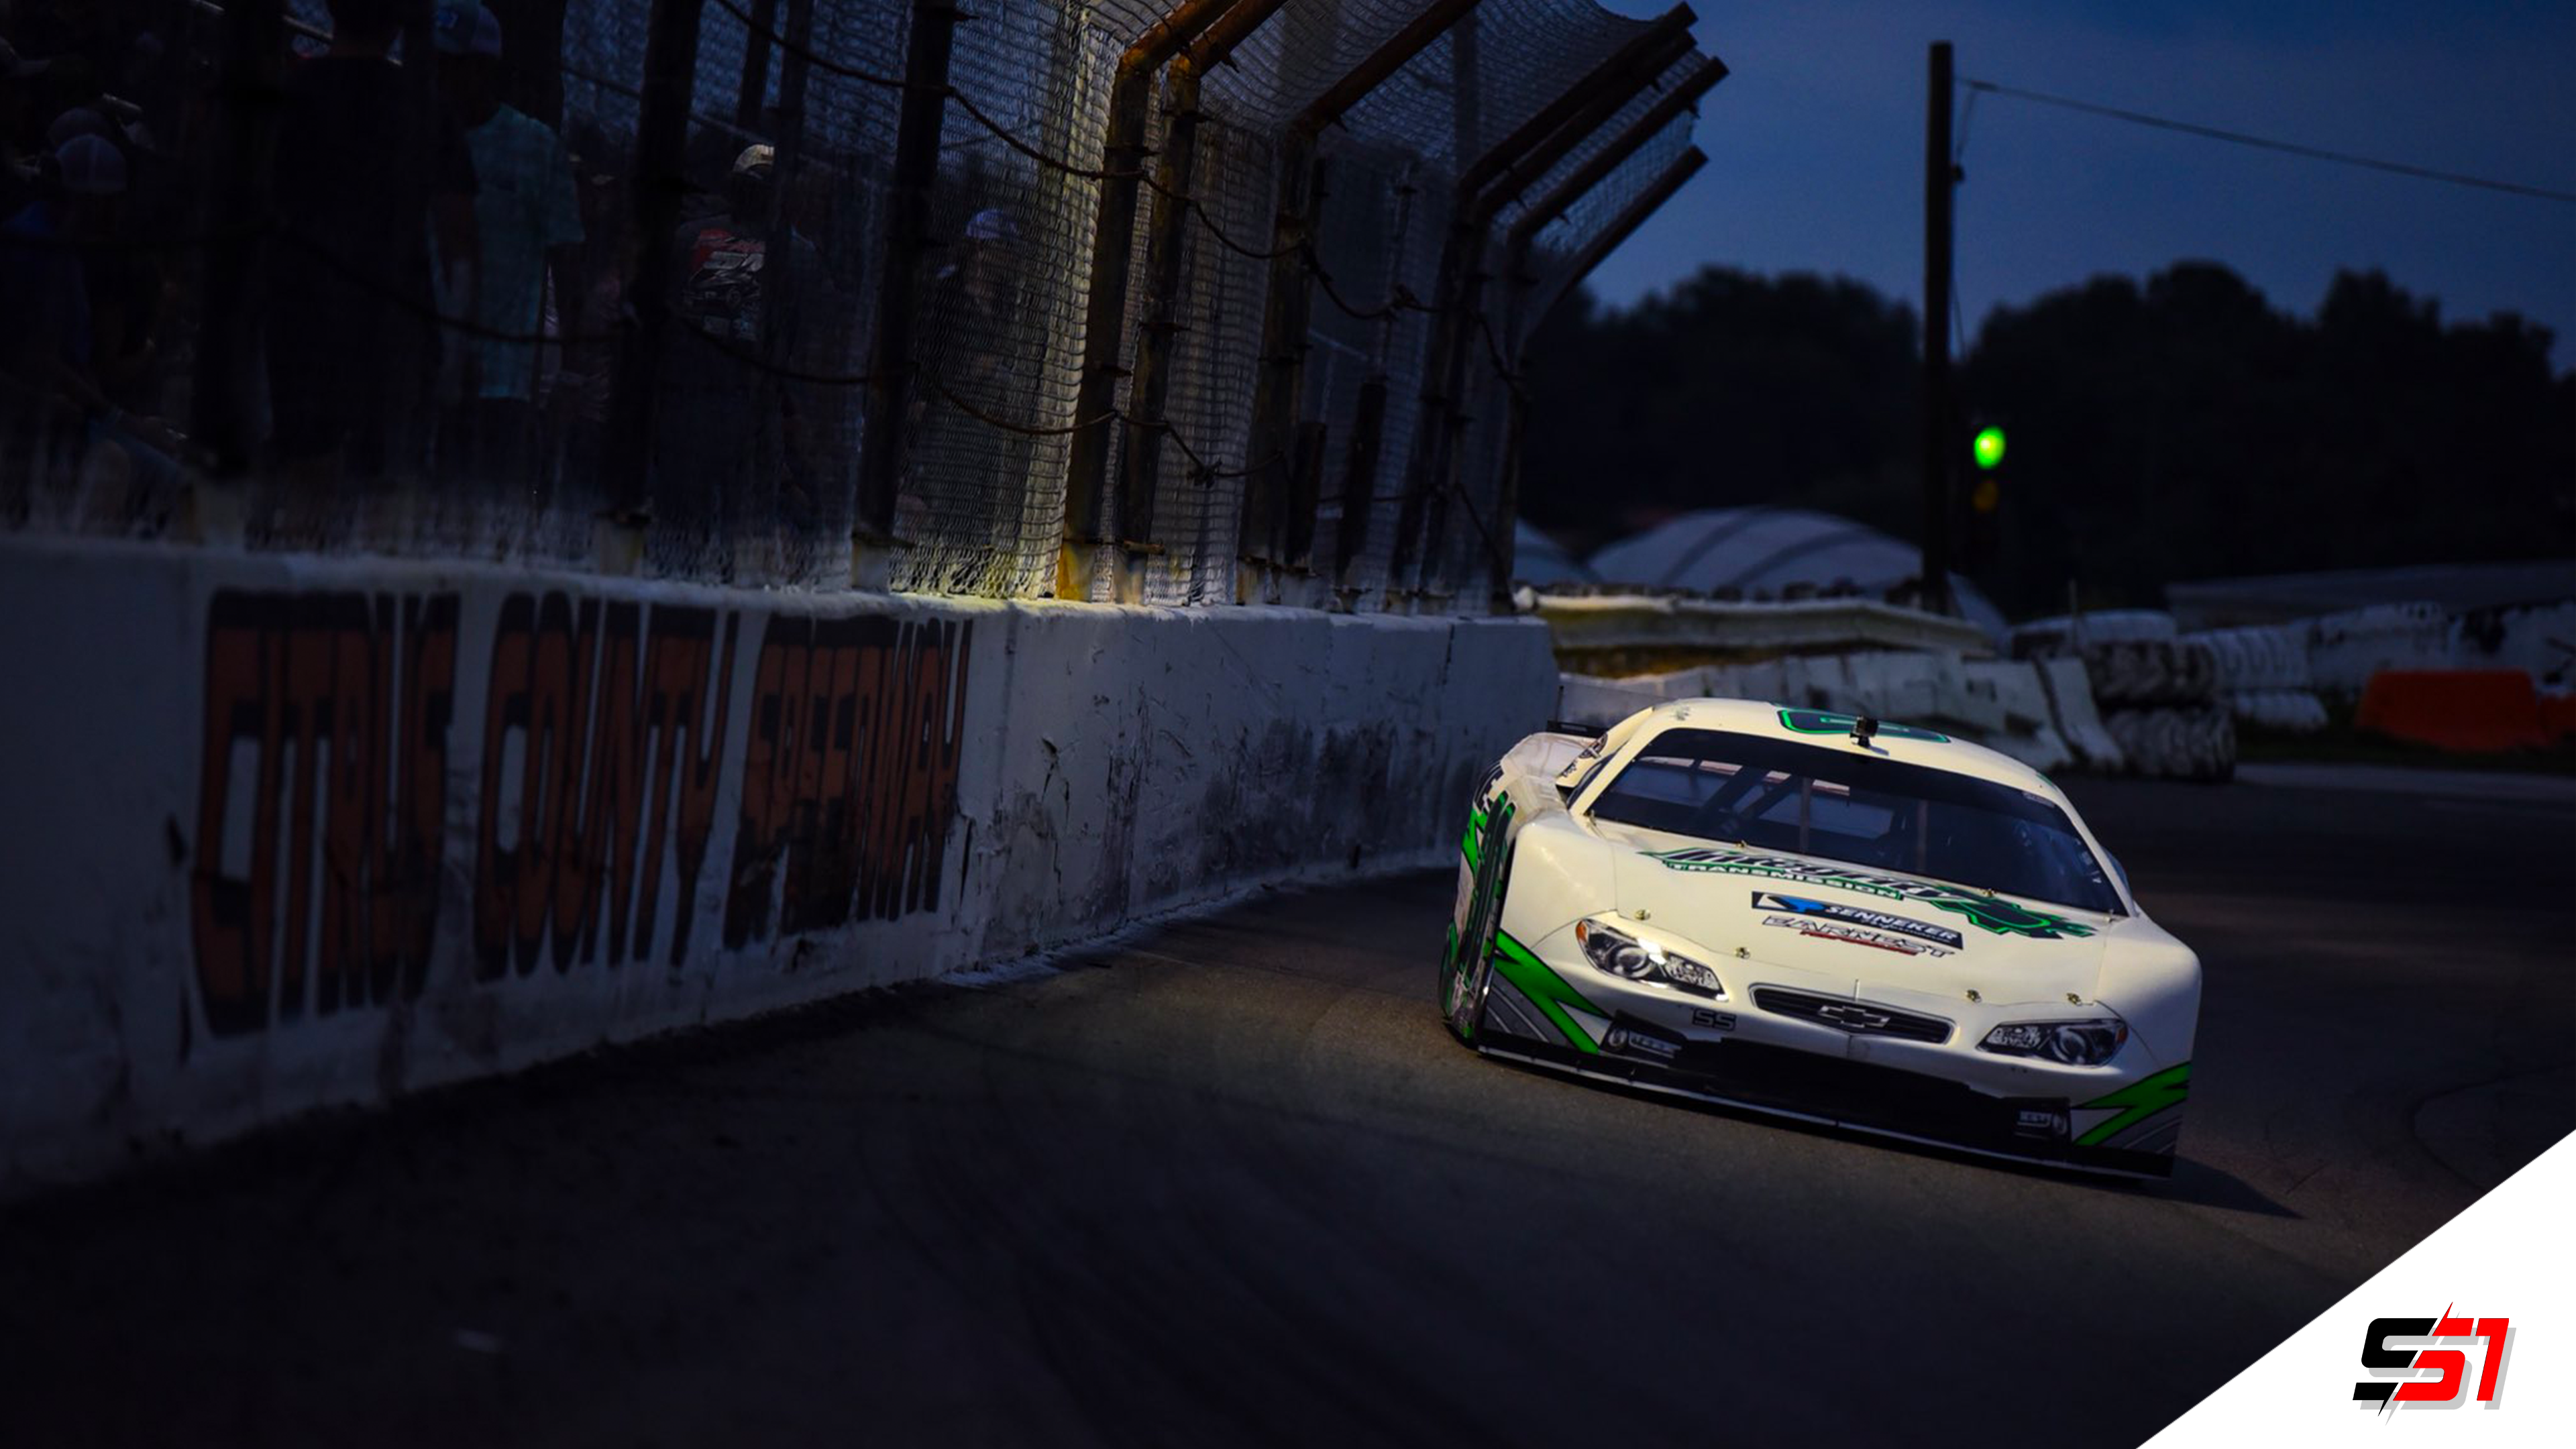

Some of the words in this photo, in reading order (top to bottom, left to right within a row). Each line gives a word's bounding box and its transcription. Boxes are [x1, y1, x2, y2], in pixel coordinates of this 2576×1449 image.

[193, 588, 462, 1038] CITRUS
[472, 590, 741, 983] COUNTY
[724, 612, 973, 950] SPEEDWAY
[1668, 863, 1905, 901] TRANSMISSION
[1762, 915, 1955, 958] EARNEST
[1825, 906, 1958, 941] SENNEKER
